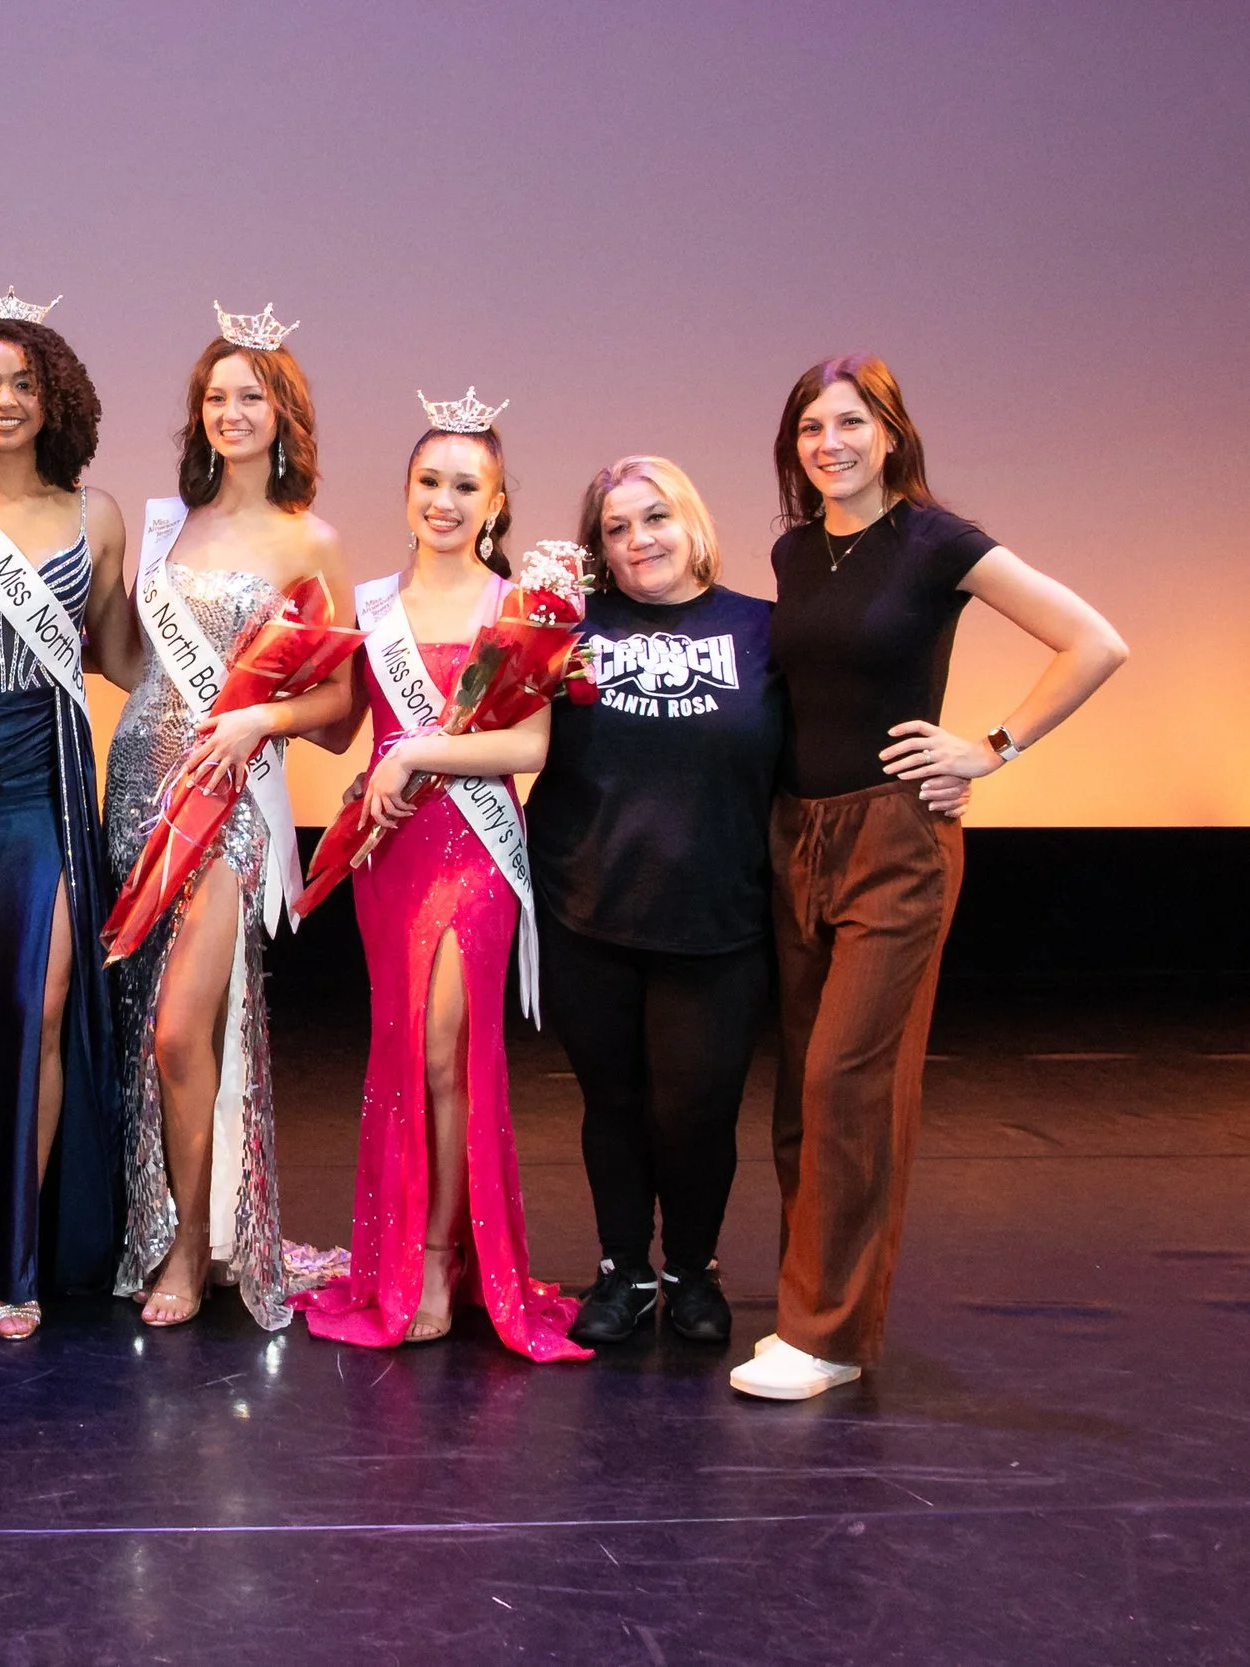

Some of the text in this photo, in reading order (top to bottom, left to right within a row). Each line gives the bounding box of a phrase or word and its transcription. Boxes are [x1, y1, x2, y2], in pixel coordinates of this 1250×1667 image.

[143, 556, 163, 604] Miss
[26, 604, 75, 668] North
[151, 602, 199, 670] North
[601, 688, 719, 718] SANTA ROSA
[381, 637, 411, 683] Miss
[462, 775, 516, 844] ounty's
[508, 838, 531, 893] Teen
